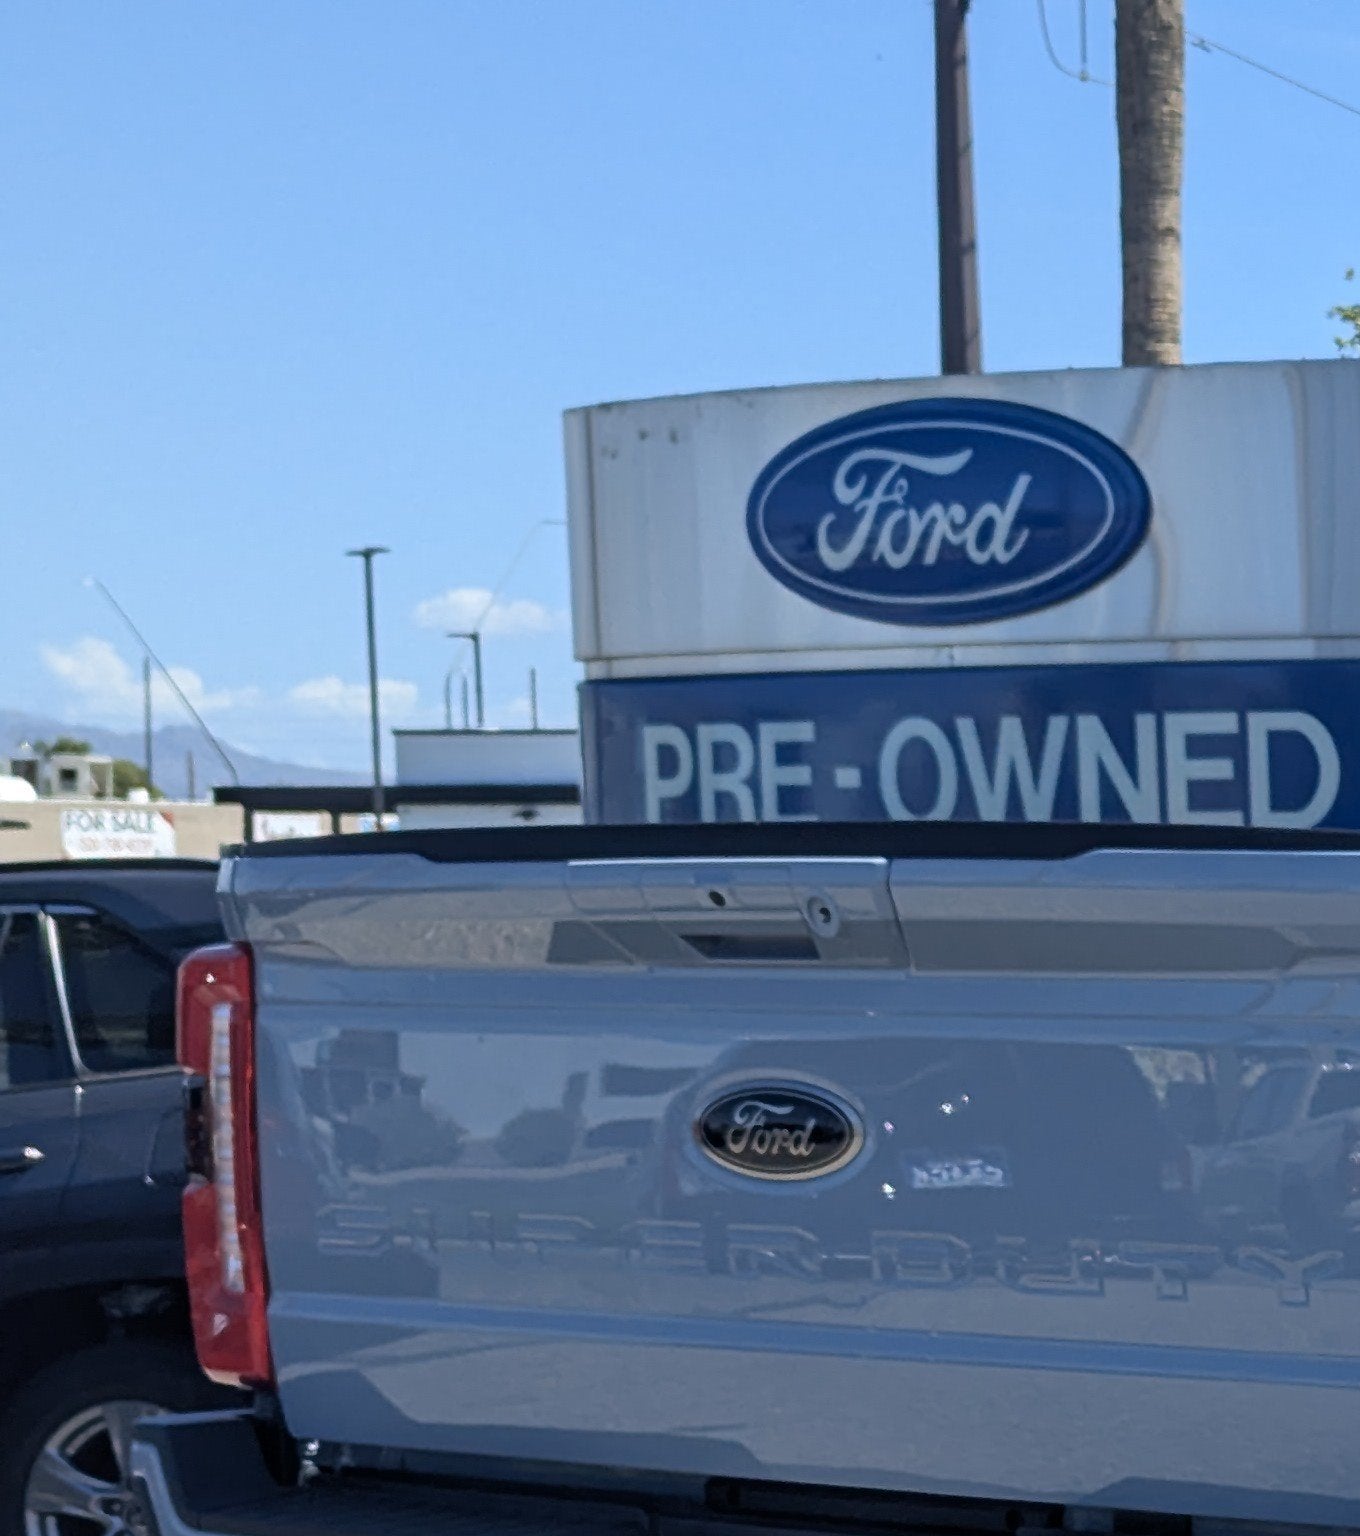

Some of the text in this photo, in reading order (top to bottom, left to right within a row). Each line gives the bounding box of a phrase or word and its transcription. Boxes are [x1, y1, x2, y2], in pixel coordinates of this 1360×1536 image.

[817, 448, 1033, 571] Ford
[66, 810, 104, 832] FOR
[726, 1101, 816, 1156] Ford
